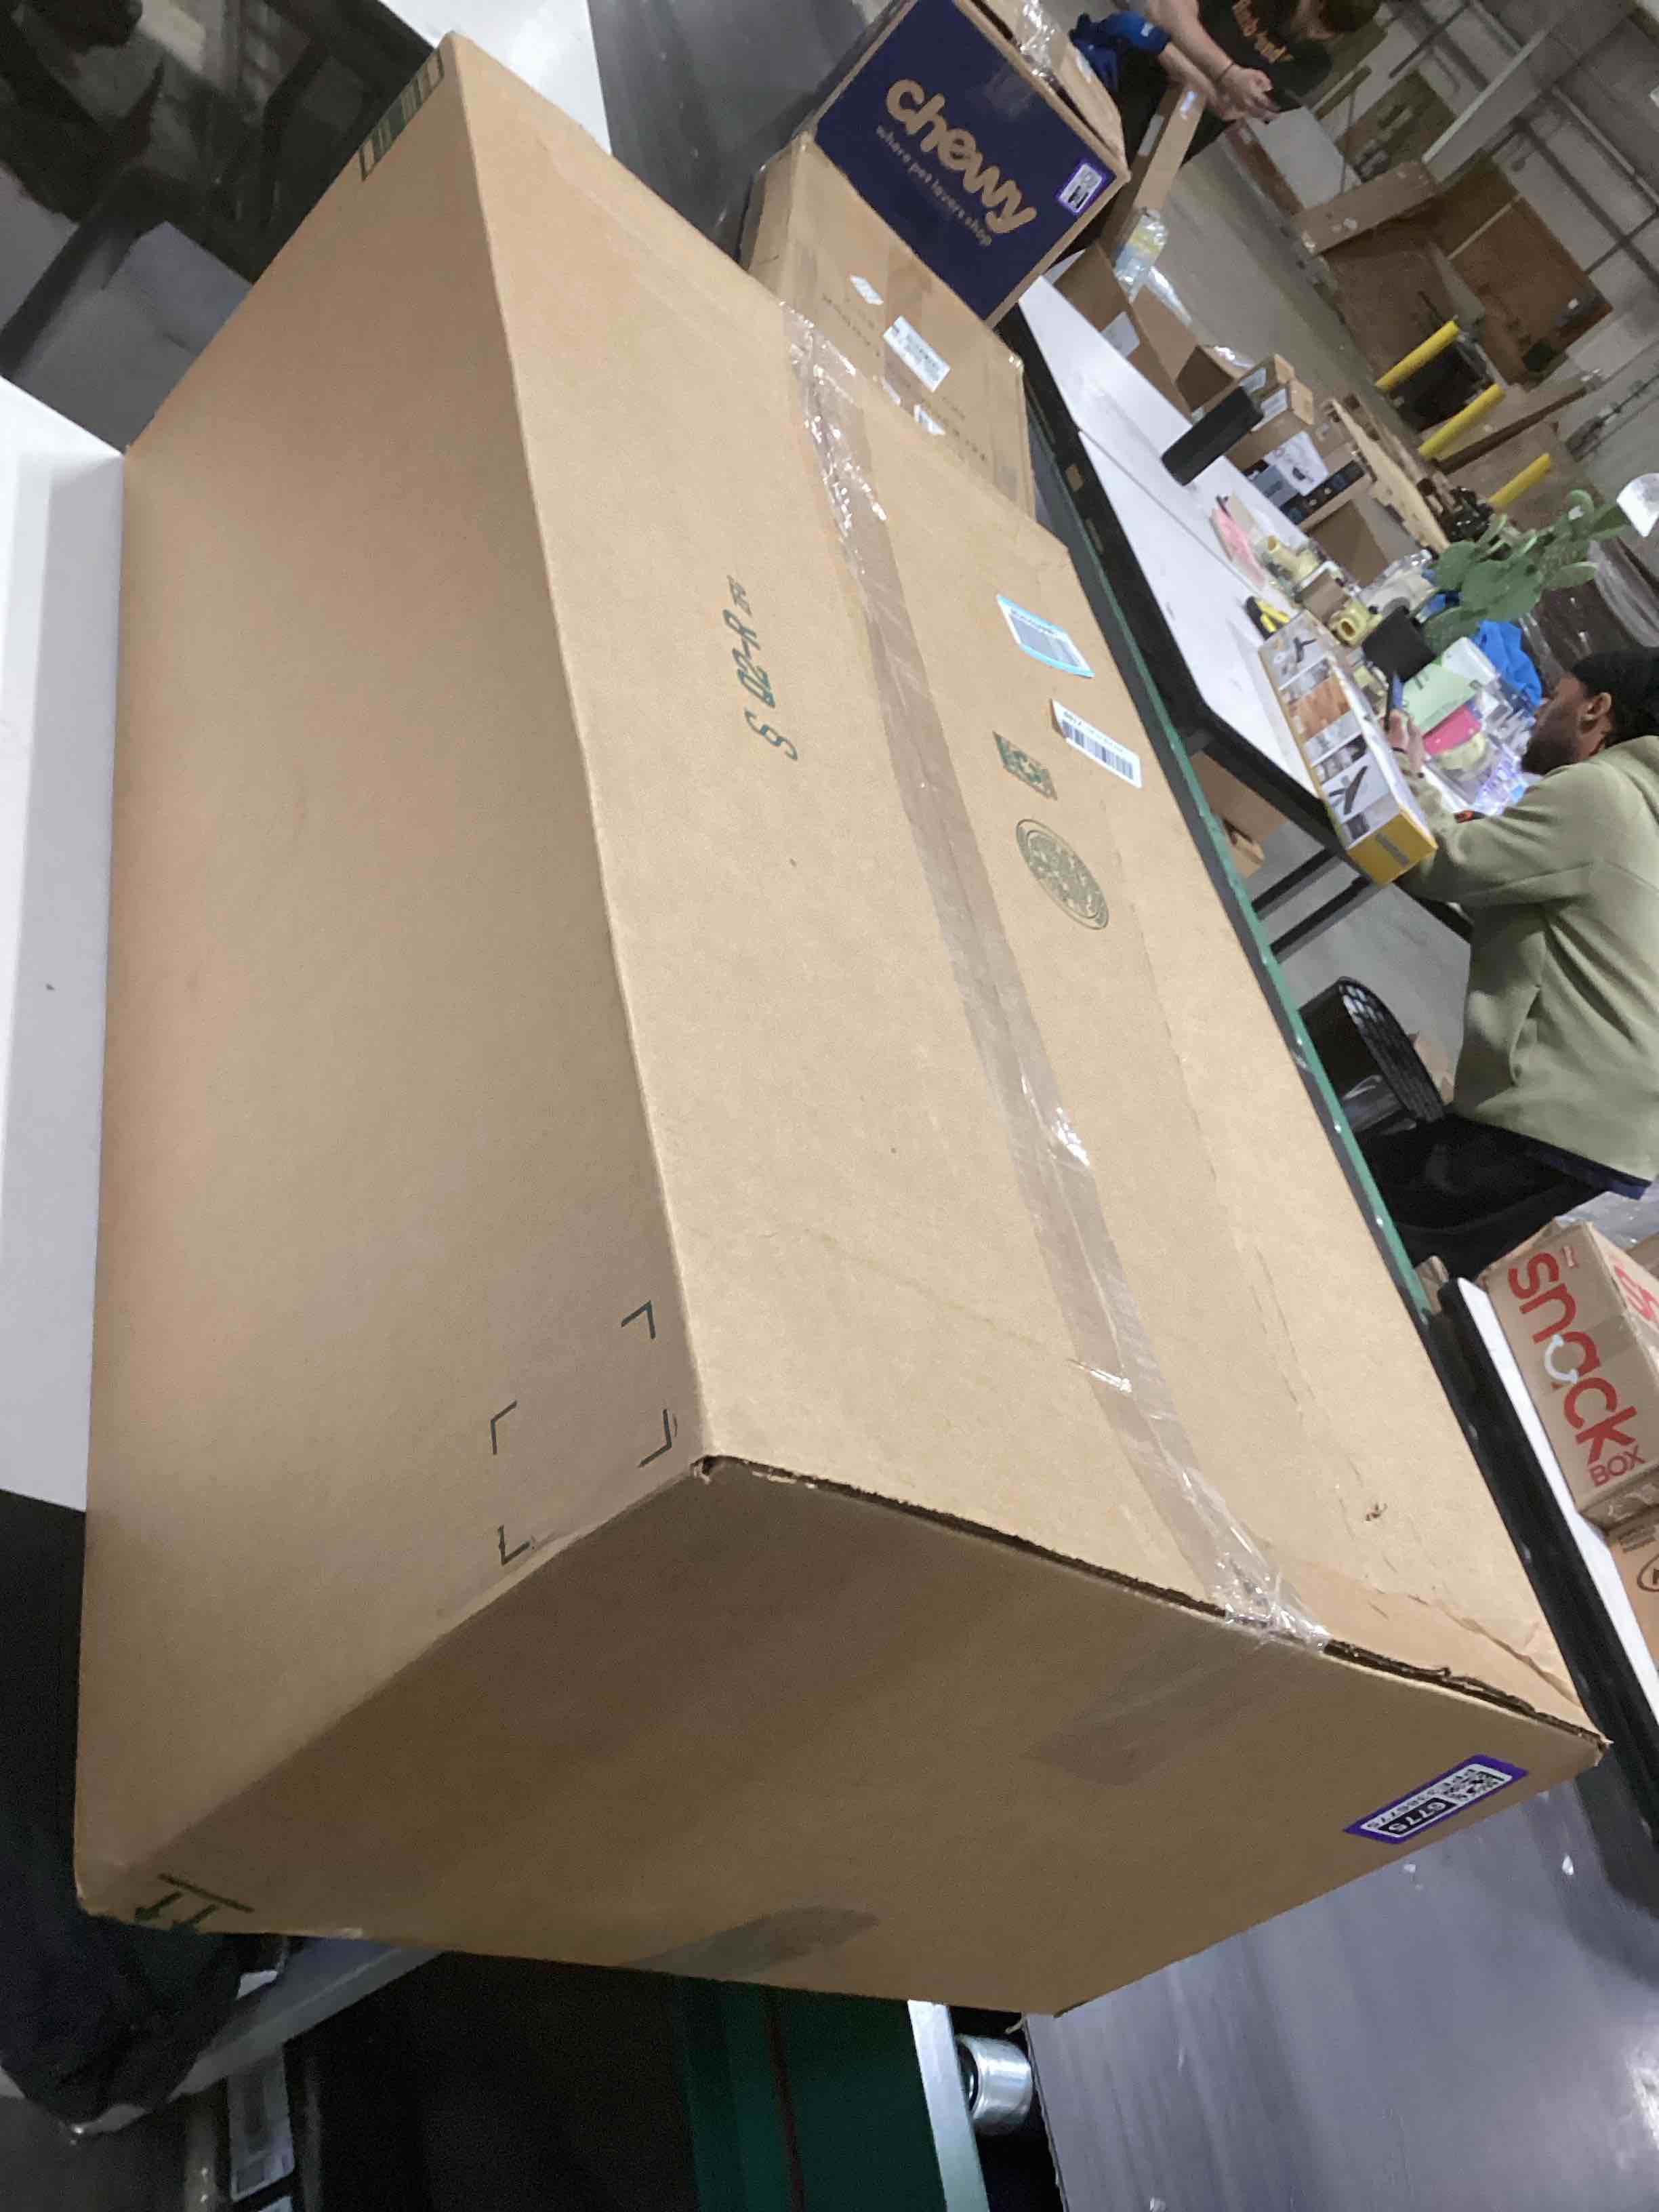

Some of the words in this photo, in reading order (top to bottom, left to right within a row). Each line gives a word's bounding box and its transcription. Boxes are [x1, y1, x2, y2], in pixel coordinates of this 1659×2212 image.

[886, 79, 1037, 233] chewy
[1507, 1252, 1637, 1466] snack
[1590, 1444, 1645, 1487] BOX
